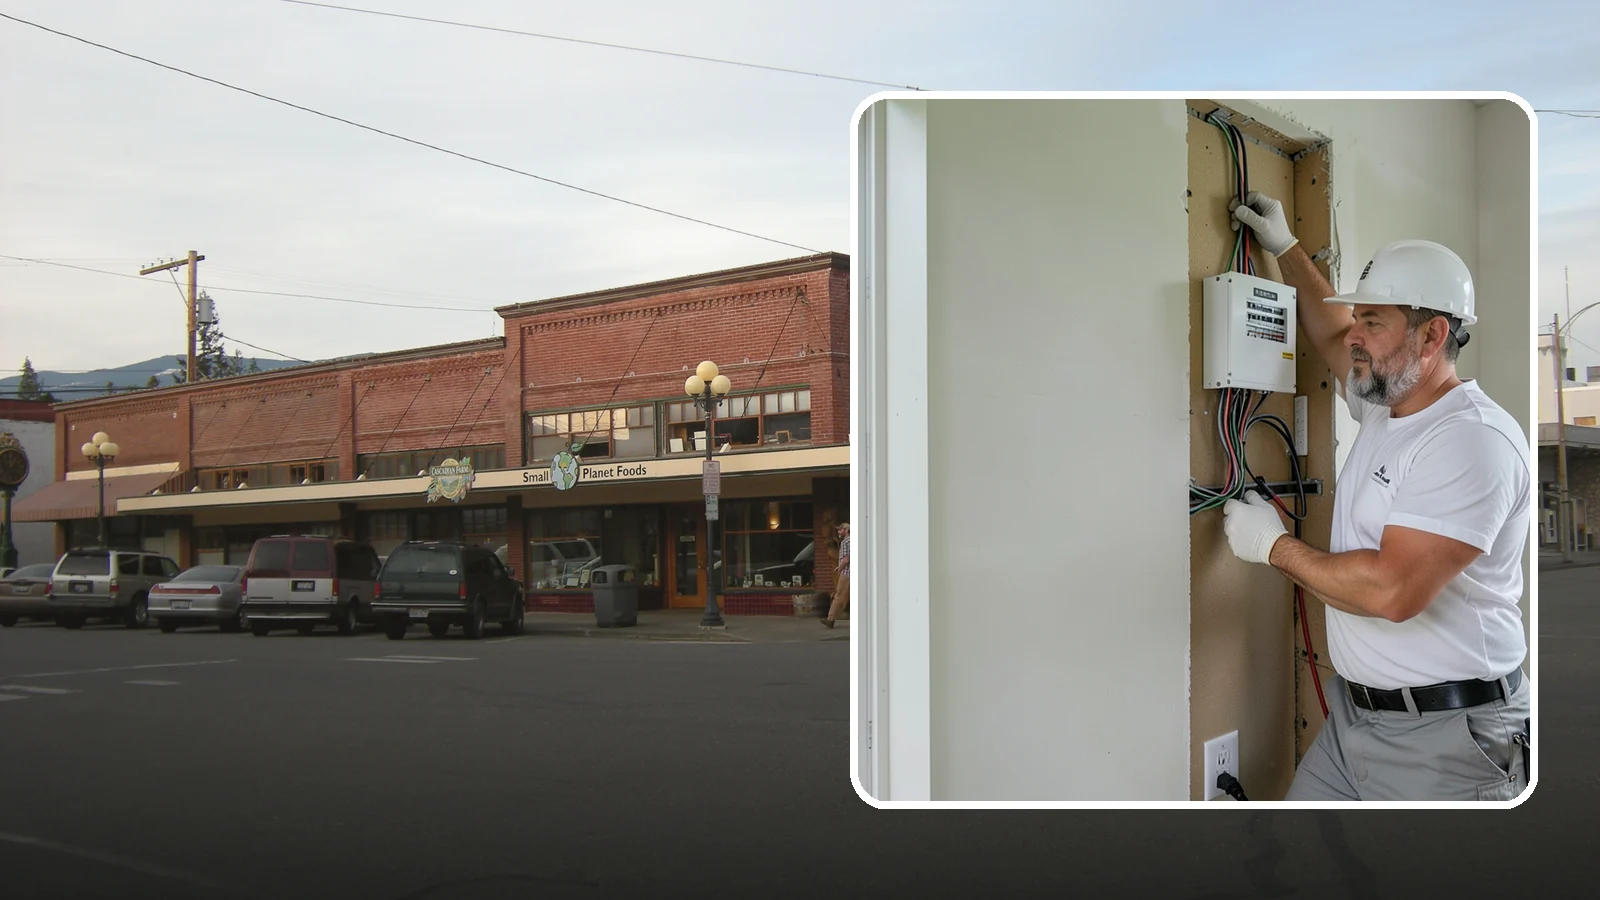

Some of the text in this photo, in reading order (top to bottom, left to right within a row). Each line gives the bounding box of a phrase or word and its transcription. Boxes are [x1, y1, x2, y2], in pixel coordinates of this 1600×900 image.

[523, 464, 647, 482] Small Planet Foods
